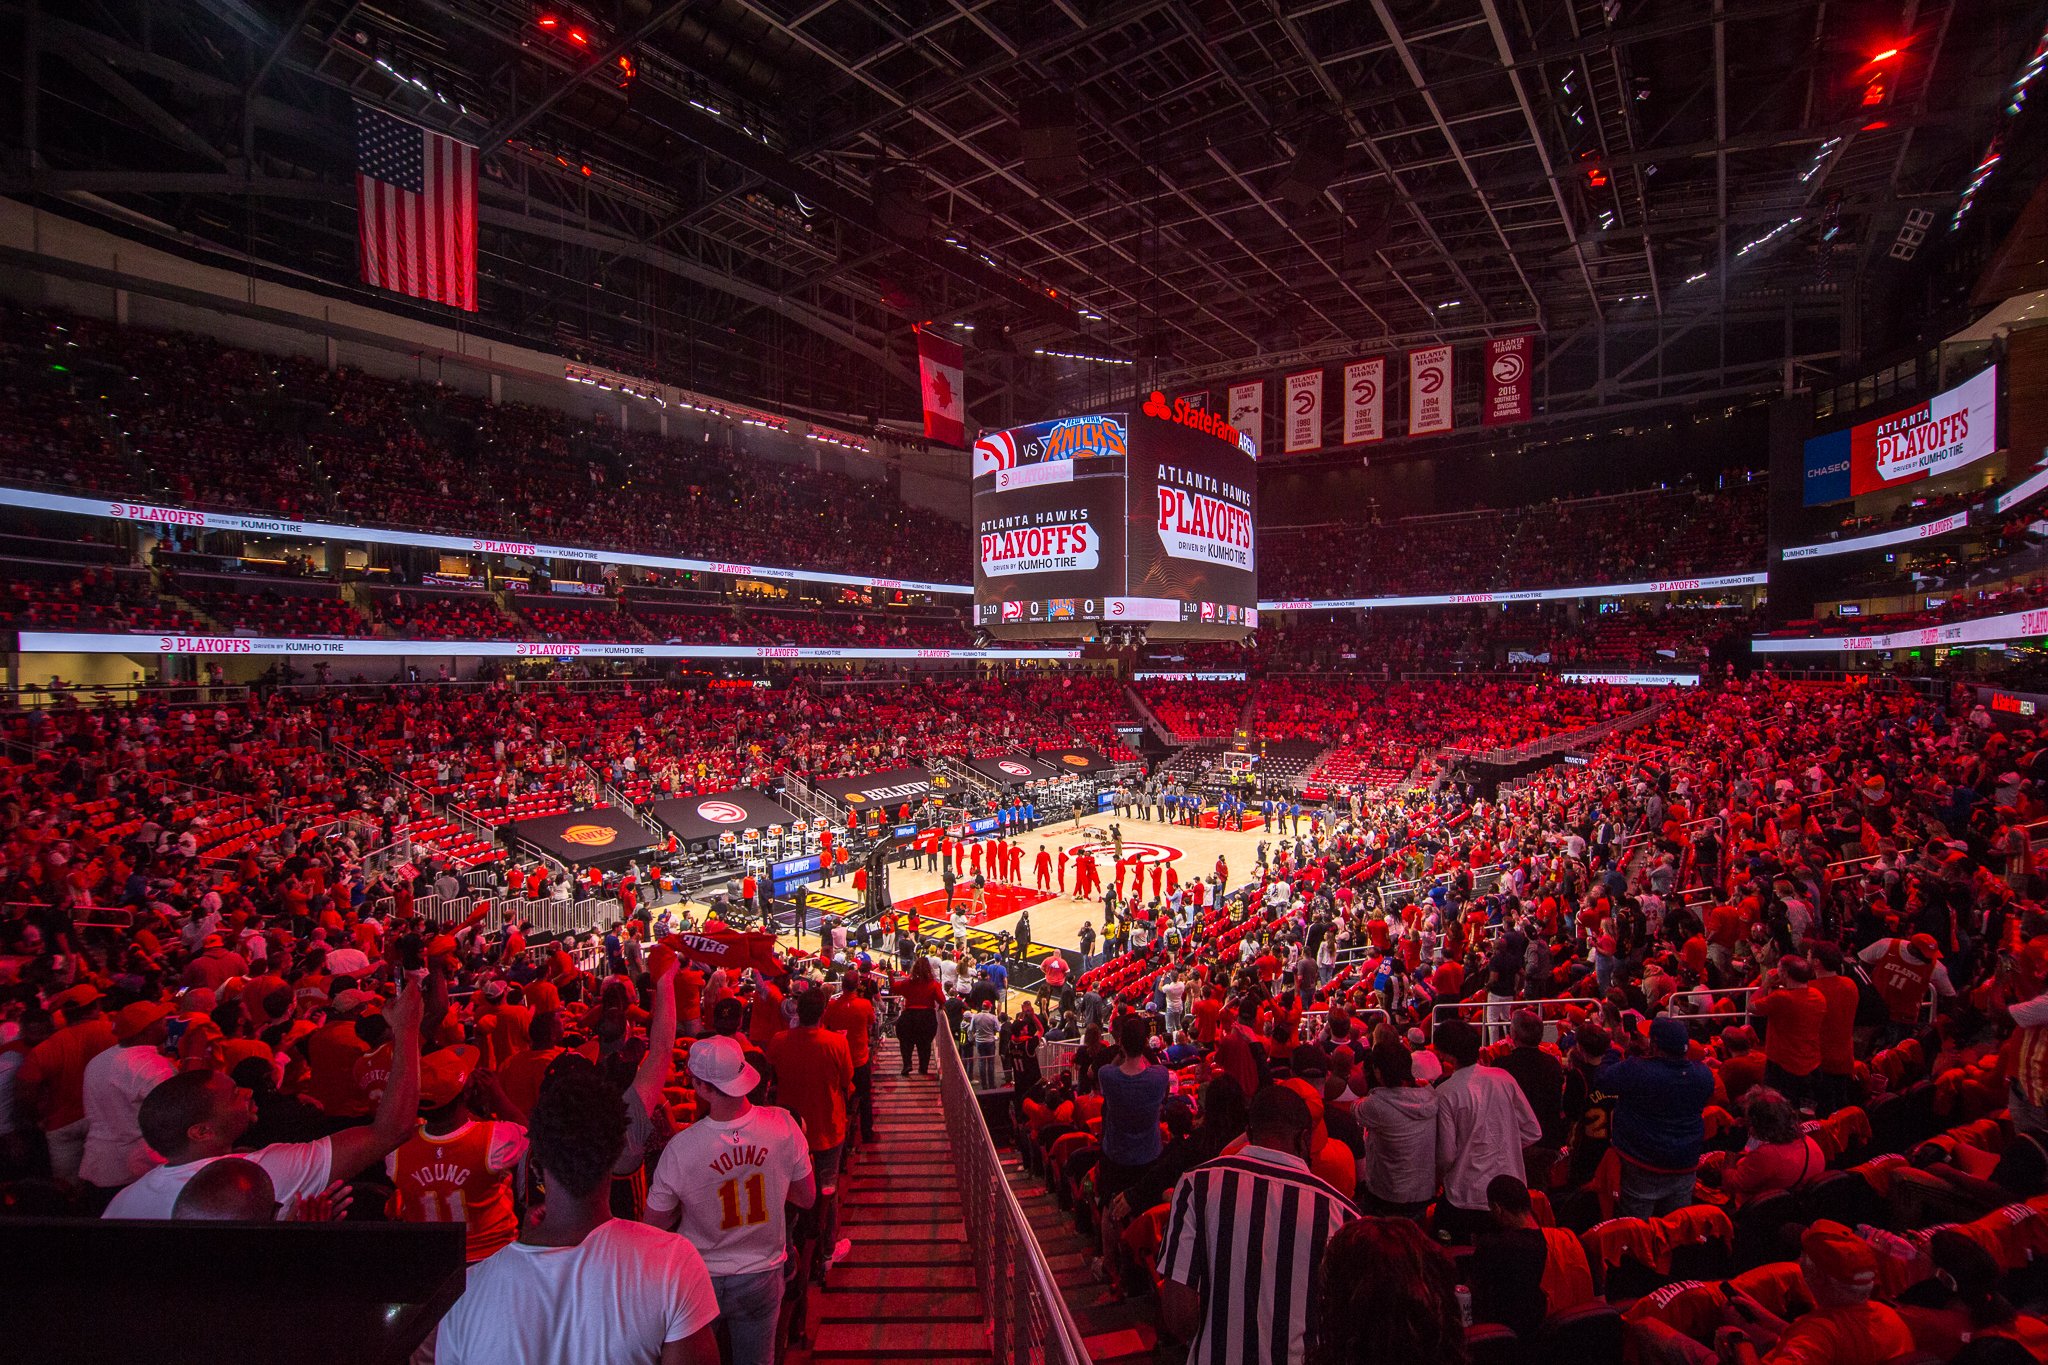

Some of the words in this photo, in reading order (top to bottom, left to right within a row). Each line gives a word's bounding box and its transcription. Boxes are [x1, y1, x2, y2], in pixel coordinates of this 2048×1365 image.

[1493, 338, 1524, 348] ATLANTA
[1495, 344, 1522, 353] HAWKS
[1414, 350, 1447, 360] ATLANTA
[1417, 356, 1444, 366] HAWKS
[1349, 363, 1379, 373] ATLANTA
[1352, 370, 1376, 378] HAWKS
[1290, 374, 1318, 384] ATLANTA
[1236, 386, 1255, 394] ATLANTA
[1498, 385, 1516, 395] 2015
[1423, 398, 1438, 407] 1994
[1494, 394, 1520, 403] SOUTHEAST
[1421, 406, 1440, 414] CENTRAL
[1497, 402, 1517, 410] DIVISION
[1356, 409, 1371, 418] 1987
[1421, 413, 1439, 421] DIVISION
[1493, 408, 1520, 418] CHAMPIONS
[1418, 419, 1442, 428] CHAMPIONS
[1876, 408, 1929, 436] ATLANTA
[1044, 421, 1125, 462] KNICKS
[1878, 407, 1968, 466] PLAYOFFS
[1023, 443, 1038, 458] VS
[1238, 432, 1256, 461] ARENA
[1893, 464, 1911, 473] DRIVEN
[1912, 461, 1918, 469] BY
[1919, 449, 1948, 467] KUMHO
[1949, 443, 1964, 458] TIRE
[1808, 464, 1840, 478] CHASE
[1158, 464, 1217, 493] ATLANTA
[1223, 482, 1250, 506] HAWKS
[128, 505, 205, 526] PLAYOFFS
[241, 520, 279, 531] KUMHO
[280, 524, 302, 533] TIRE
[981, 515, 1028, 532] ATLANTA
[1036, 509, 1088, 524] HAWKS
[1160, 489, 1250, 549] PLAYOFFS
[1928, 518, 1953, 535] PLAYOFFS
[485, 541, 535, 555] PLAYOFFS
[982, 524, 1086, 562] PLAYOFFS
[1179, 542, 1199, 552] DRIVEN
[1208, 544, 1233, 561] KUMHO
[1234, 550, 1246, 564] TIRE
[1805, 548, 1818, 556] TIRE
[717, 564, 751, 575] PLAYOFFS
[1018, 558, 1052, 570] KUMHO
[1054, 557, 1076, 567] TIRE
[876, 579, 901, 588] PLAYOFFS
[1659, 580, 1699, 590] PLAYOFFS
[1720, 577, 1741, 585] KUMHO
[1457, 594, 1492, 602] PLAYOFFS
[983, 605, 997, 614] 1:10
[1030, 602, 1038, 615] 0
[1084, 600, 1094, 613] 0
[1184, 603, 1197, 612] 1:10
[1218, 605, 1223, 617] 0
[1240, 608, 1243, 619] 0
[177, 638, 250, 652] PLAYOFFS
[286, 642, 322, 651] KUMHO
[1850, 638, 1872, 648] PLAYOFFS
[529, 644, 580, 655] PLAYOFFS
[765, 648, 799, 656] PLAYOFFS
[560, 827, 618, 843] HAWKS
[1884, 963, 1922, 983] ATLANTA
[1889, 974, 1907, 990] 11
[709, 1145, 768, 1176] YOUNG
[411, 1164, 470, 1187] YOUNG
[419, 1189, 467, 1222] 11
[718, 1173, 769, 1230] 11
